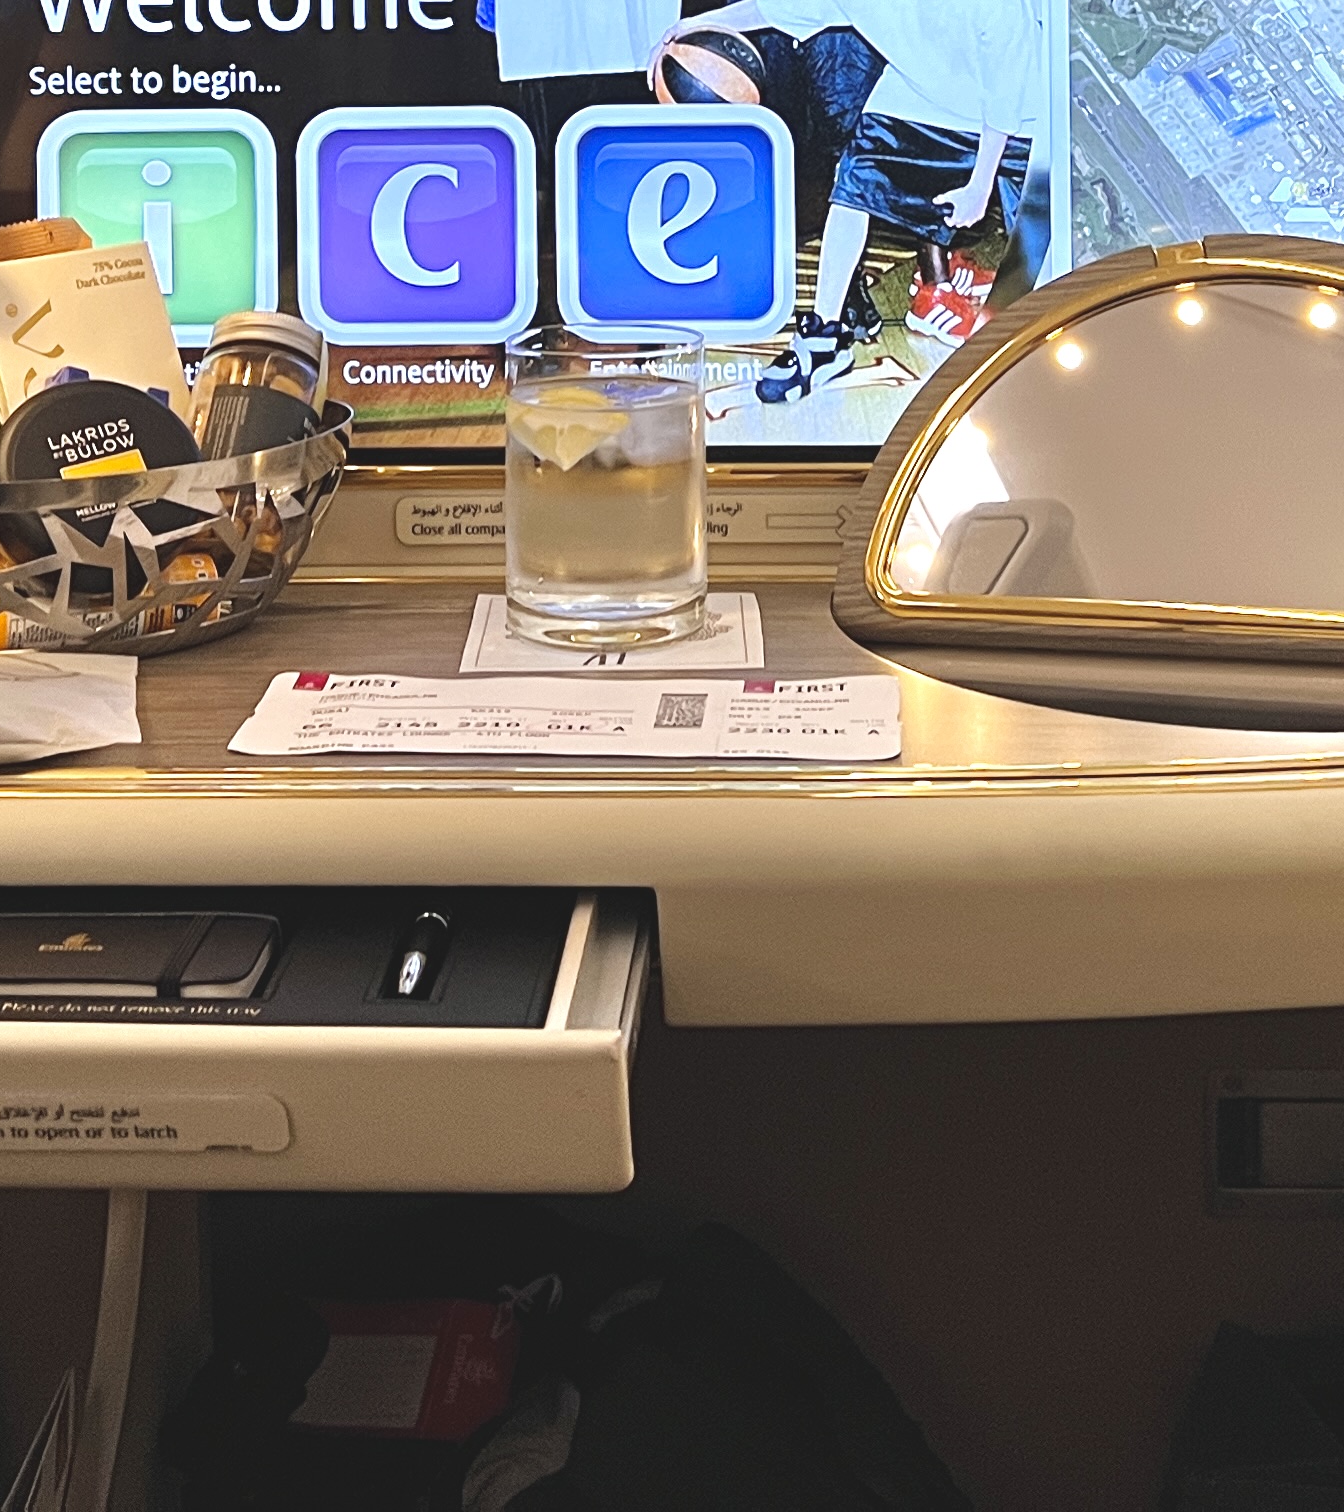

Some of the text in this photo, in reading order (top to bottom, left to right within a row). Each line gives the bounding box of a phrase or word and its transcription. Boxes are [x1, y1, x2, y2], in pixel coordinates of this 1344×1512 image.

[28, 64, 283, 101] Select to begin...
[140, 158, 173, 295] i
[92, 261, 114, 274] 75%
[75, 271, 146, 290] Dark Chocolate
[342, 358, 496, 389] Connectivity
[46, 418, 131, 451] LAKRIDS
[411, 523, 445, 536] Close
[447, 523, 462, 536] all
[329, 679, 401, 690] FIRST
[778, 681, 848, 693] FIRST
[59, 1003, 81, 1013] do
[87, 1003, 116, 1013] not
[120, 1004, 185, 1014] remove
[189, 1005, 221, 1014] this
[9, 1126, 29, 1139] to
[34, 1127, 81, 1142] open
[85, 1127, 105, 1139] or
[110, 1126, 130, 1139] to
[134, 1124, 178, 1139] latch
